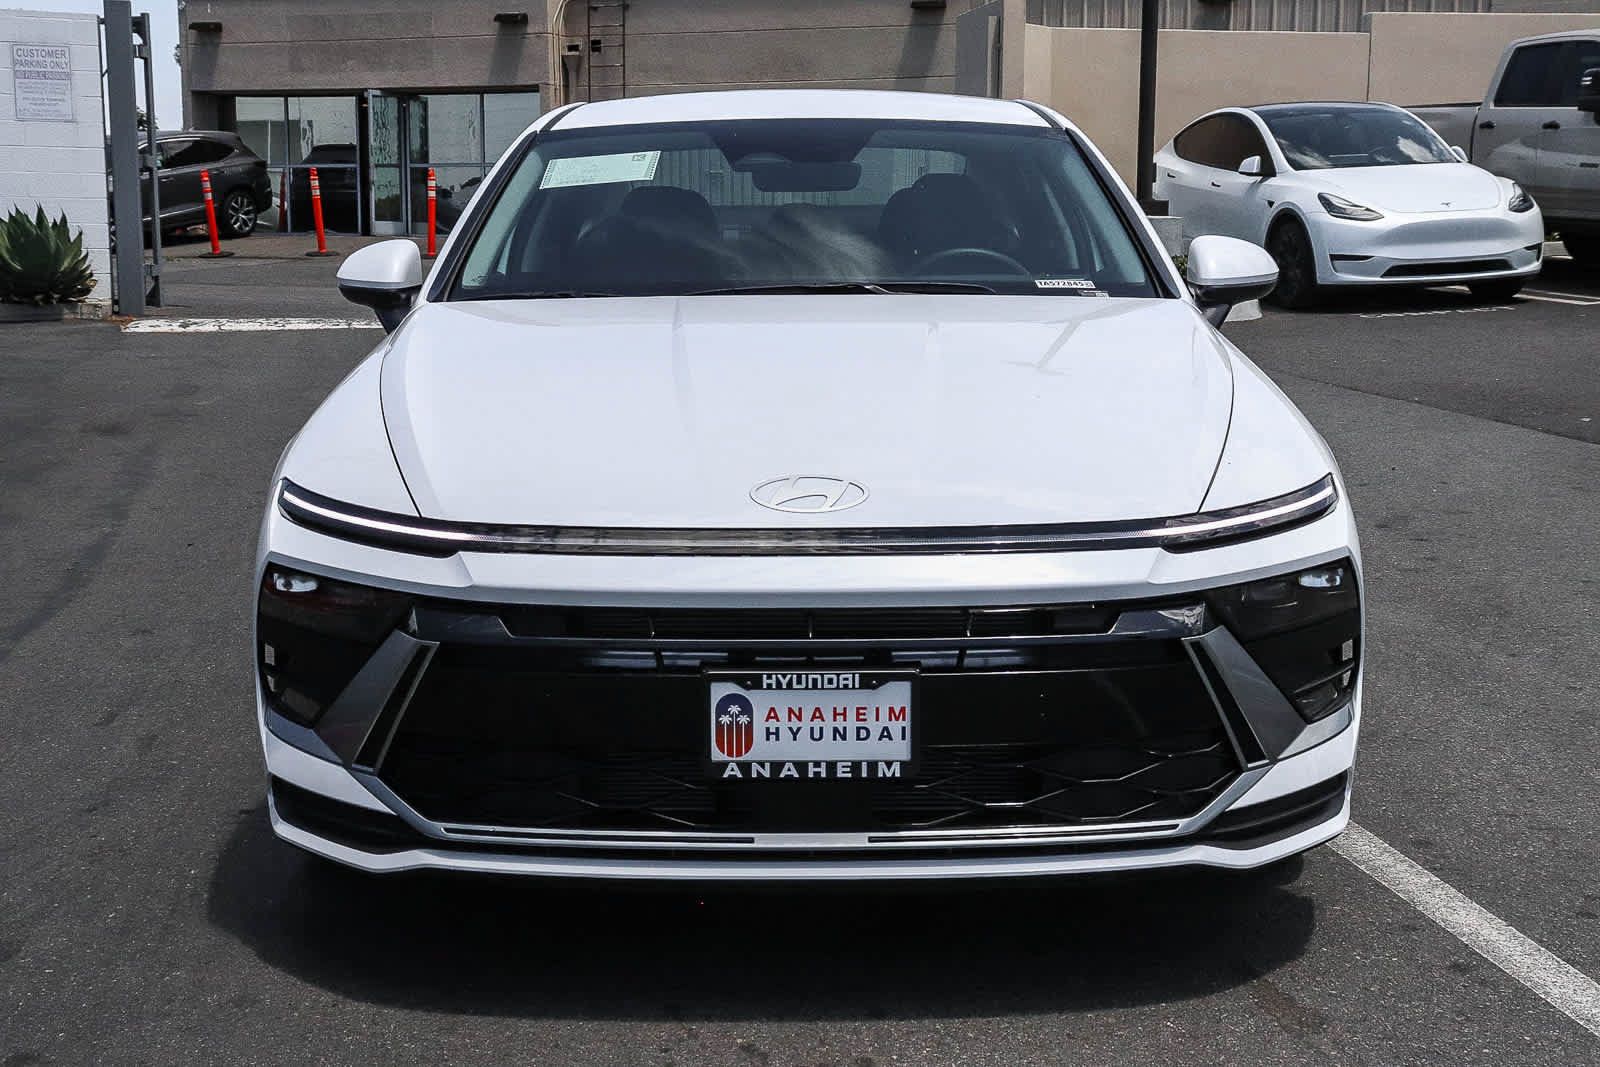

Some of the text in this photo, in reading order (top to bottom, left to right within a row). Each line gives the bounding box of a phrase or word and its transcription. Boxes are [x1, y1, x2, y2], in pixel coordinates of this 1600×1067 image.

[16, 48, 67, 59] CUSTOMER
[15, 59, 69, 70] PARKING ONLY
[762, 674, 860, 689] HYUNDAI
[764, 706, 907, 722] ANAHEIM
[765, 726, 907, 742] HYUNDAI
[722, 761, 901, 778] ANAHEIM
